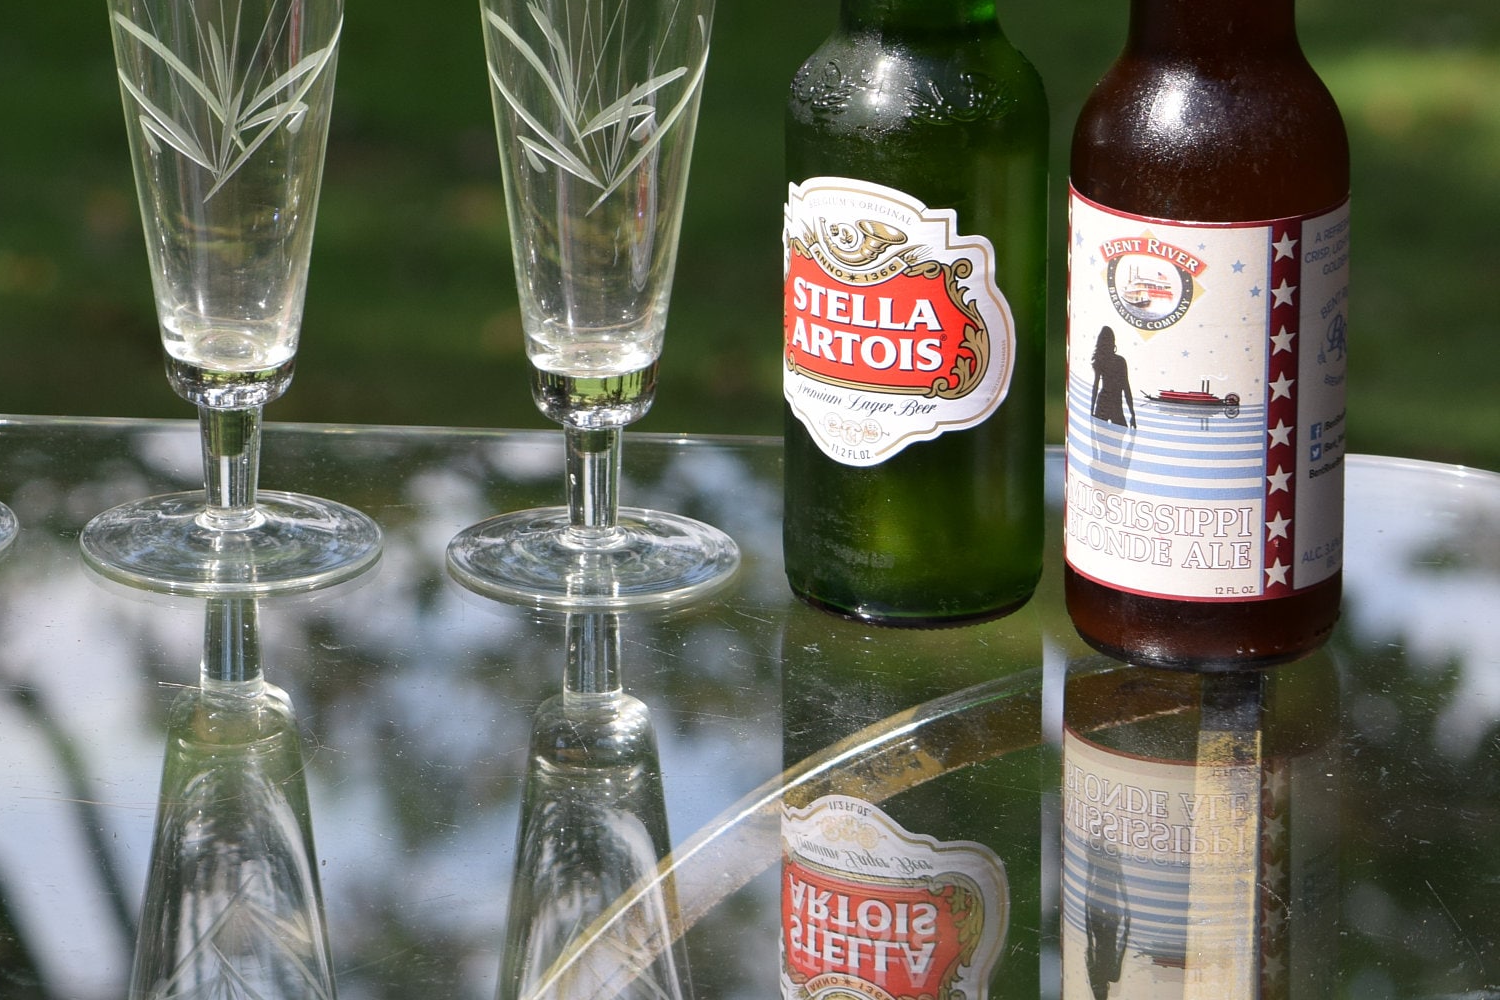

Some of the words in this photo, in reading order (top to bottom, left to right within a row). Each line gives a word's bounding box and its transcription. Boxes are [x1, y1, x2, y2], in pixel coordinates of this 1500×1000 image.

[858, 200, 912, 226] ORIGINAL
[814, 249, 843, 278] ANNO
[864, 263, 897, 281] 1366
[1102, 239, 1141, 258] BENT
[1147, 238, 1199, 272] RIVER
[793, 276, 944, 331] STELLA
[1109, 286, 1143, 328] BREWING
[1146, 297, 1190, 330] COMPANY
[792, 315, 943, 371] ARTOIS
[844, 393, 893, 417] Lager
[893, 399, 937, 416] Beer
[1068, 472, 1252, 537] MISSISSIPPI
[1068, 505, 1172, 567] BLONDE
[1181, 541, 1252, 569] ALE
[1215, 586, 1224, 594] 12
